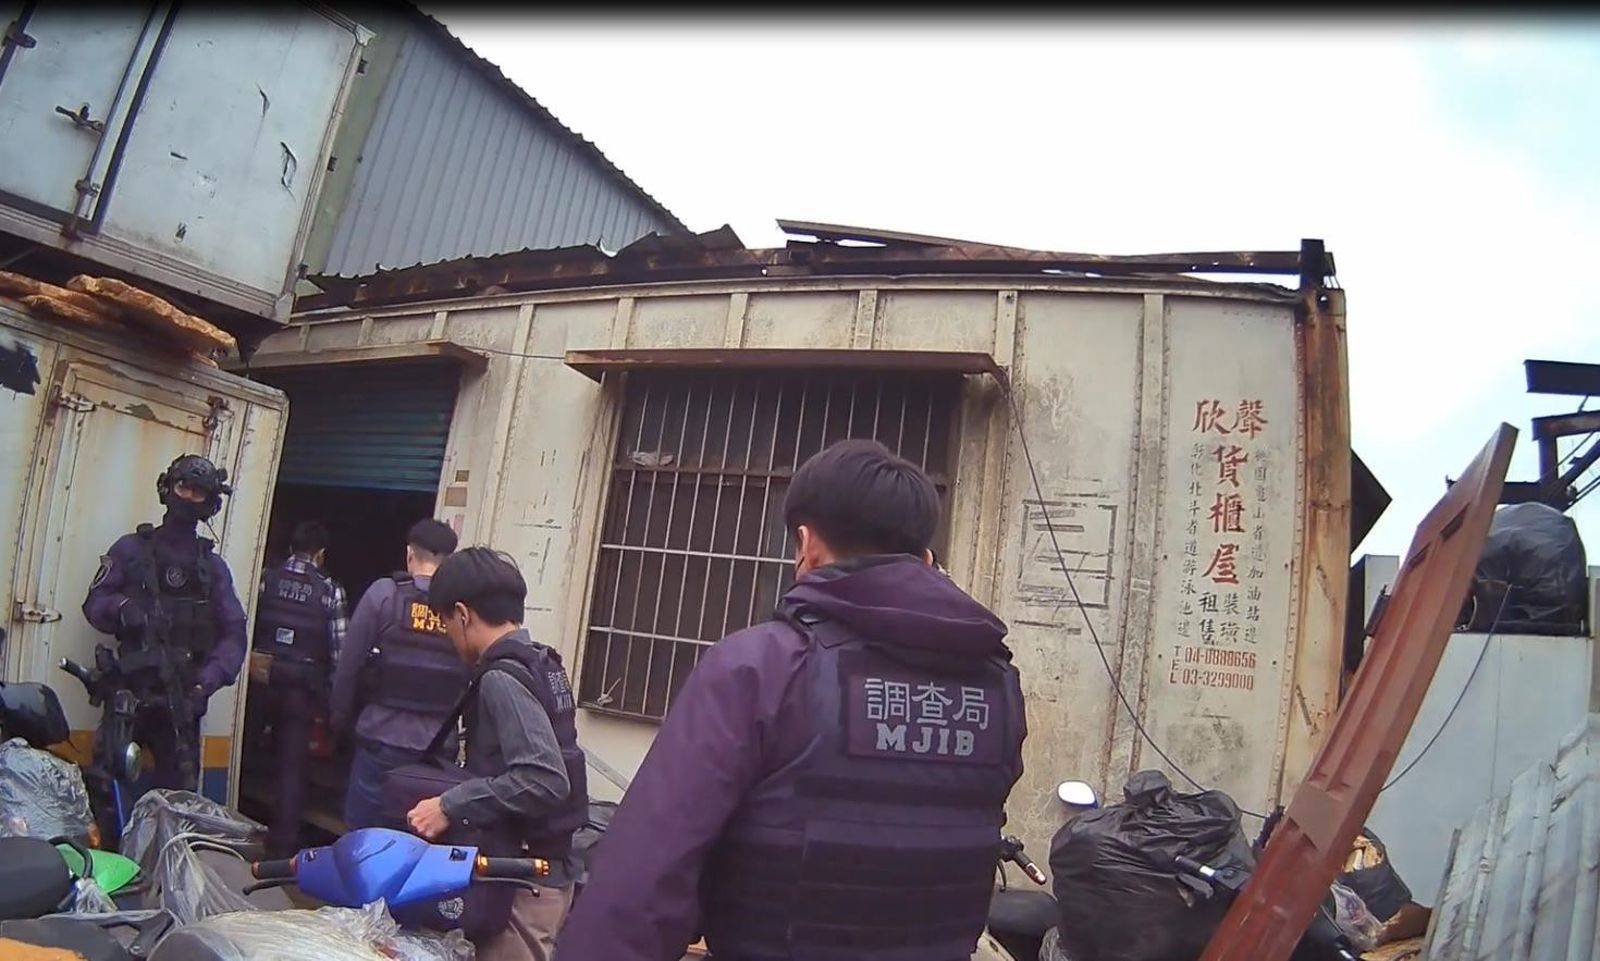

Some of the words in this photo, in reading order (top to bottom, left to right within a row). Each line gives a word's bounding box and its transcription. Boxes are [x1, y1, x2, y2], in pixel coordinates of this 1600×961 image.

[1202, 445, 1250, 585] 貨櫃屋
[1198, 591, 1219, 645] 租售
[1169, 645, 1182, 684] TEL
[1182, 668, 1255, 691] 03-3299000
[864, 678, 990, 731] 調查局
[875, 722, 975, 757] MJIB
